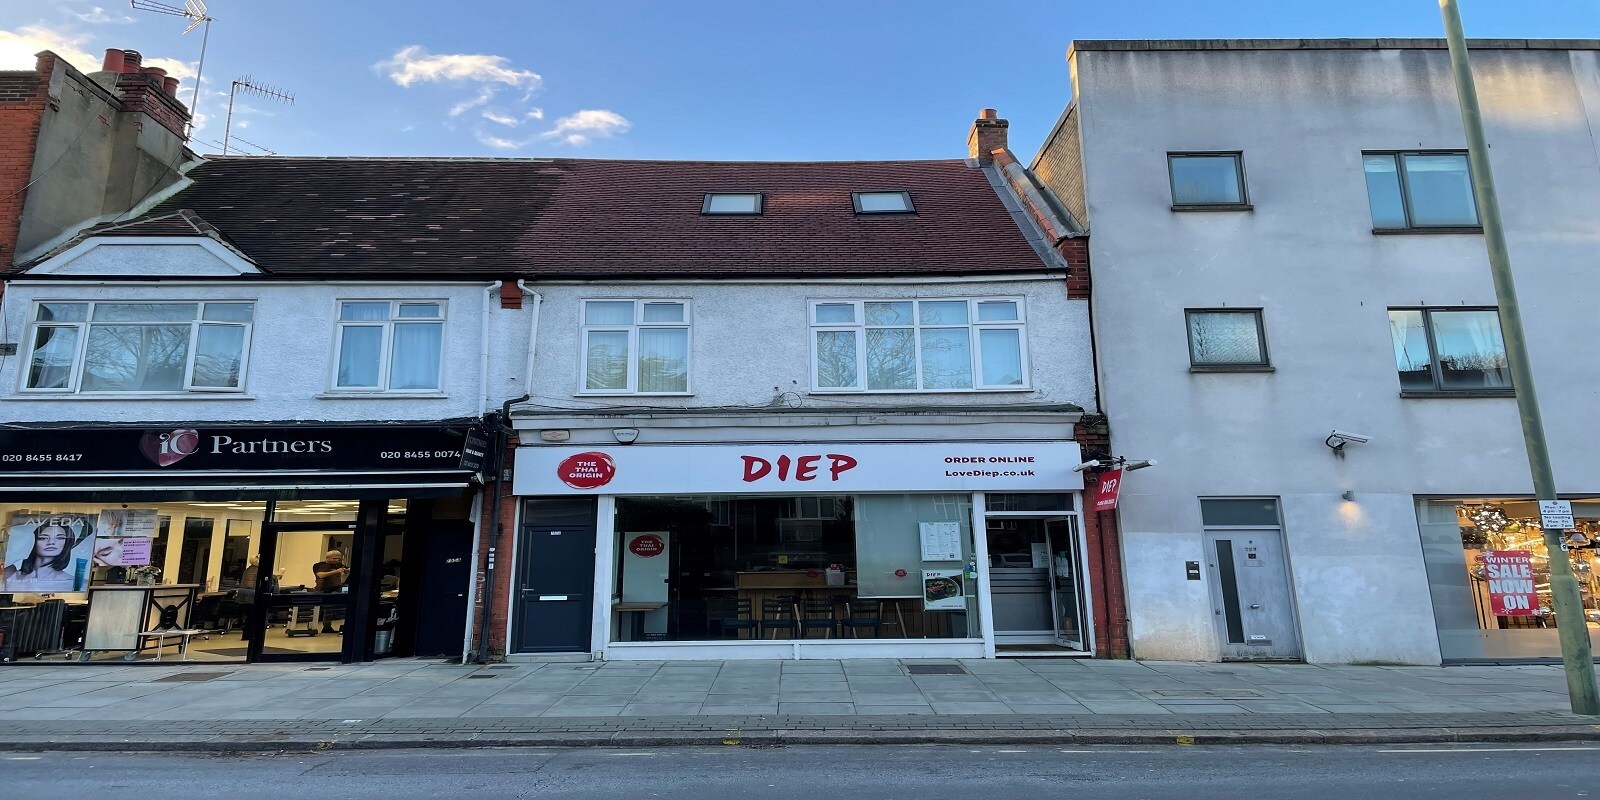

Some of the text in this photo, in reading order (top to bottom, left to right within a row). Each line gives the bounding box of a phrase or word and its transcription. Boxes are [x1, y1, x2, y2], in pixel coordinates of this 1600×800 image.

[210, 435, 332, 454] Partners
[2, 453, 83, 462] 020 8455 8417
[380, 450, 461, 459] 020 8455 0074
[740, 454, 858, 482] DIEP
[1101, 479, 1117, 494] DIEP
[24, 517, 85, 527] AVEDA
[1487, 564, 1531, 579] SALE
[1489, 580, 1533, 593] NOW
[1503, 595, 1530, 610] ON
